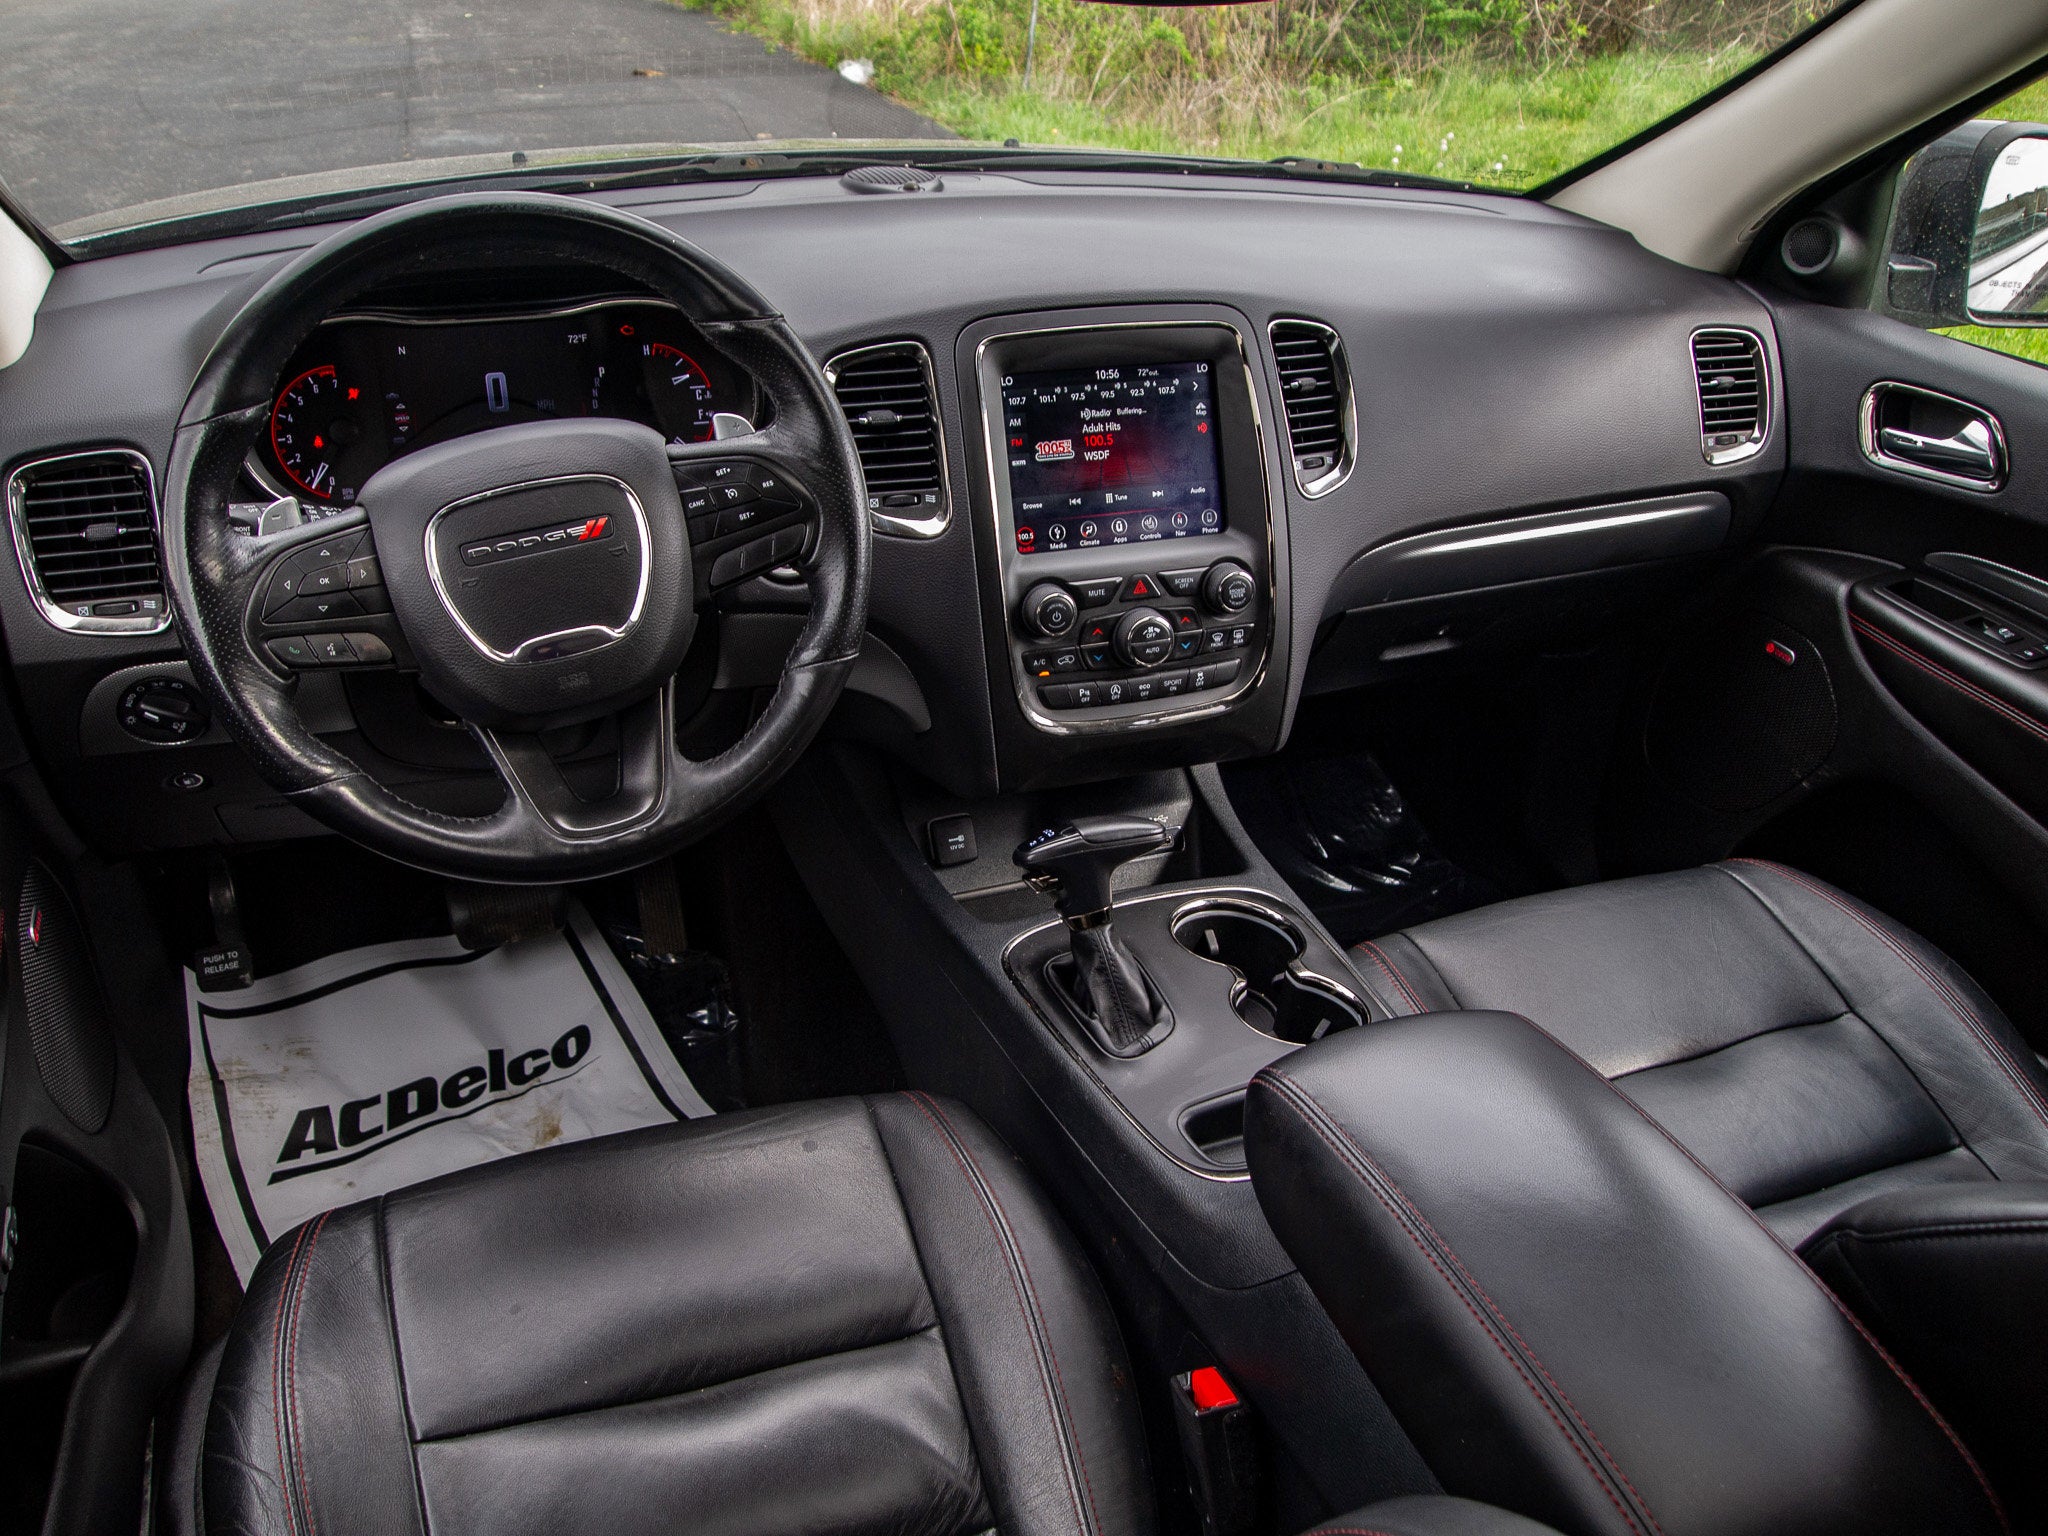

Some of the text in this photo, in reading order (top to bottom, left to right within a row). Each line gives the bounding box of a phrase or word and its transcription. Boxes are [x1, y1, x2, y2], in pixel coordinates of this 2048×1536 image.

[398, 346, 406, 355] N
[643, 344, 650, 356] H
[598, 366, 605, 378] P
[1196, 363, 1208, 373] LO
[1095, 368, 1120, 380] 10:56
[332, 379, 338, 388] 7
[1000, 376, 1013, 386] LO
[313, 384, 319, 393] 6
[1158, 386, 1175, 395] 107.5
[1071, 392, 1086, 401] 97.5
[1100, 390, 1115, 398] 99.5
[297, 397, 304, 406] 5
[1008, 396, 1026, 405] 107.7
[1040, 395, 1057, 403] 101.1
[287, 413, 294, 423] 4
[698, 409, 704, 420] F
[1009, 418, 1021, 427] AM
[1082, 422, 1121, 433] Adult Hits
[286, 434, 293, 444] 3
[1011, 438, 1023, 446] FM
[1084, 434, 1113, 447] 100.5
[295, 453, 301, 462] 2
[1084, 450, 1110, 461] WSDF
[329, 477, 335, 486] 0
[762, 480, 774, 488] RES
[1017, 532, 1034, 540] 100.5
[1140, 532, 1162, 540] Controls
[468, 525, 588, 558] DODGE
[319, 577, 330, 585] OK
[1175, 577, 1194, 585] SCREEN
[1088, 588, 1106, 597] MUTE
[1033, 658, 1046, 666] A/C
[1164, 678, 1183, 687] SPORT
[203, 951, 238, 964] PUSH TO
[204, 960, 239, 974] RELEASE
[277, 1024, 591, 1164] ACDelco
